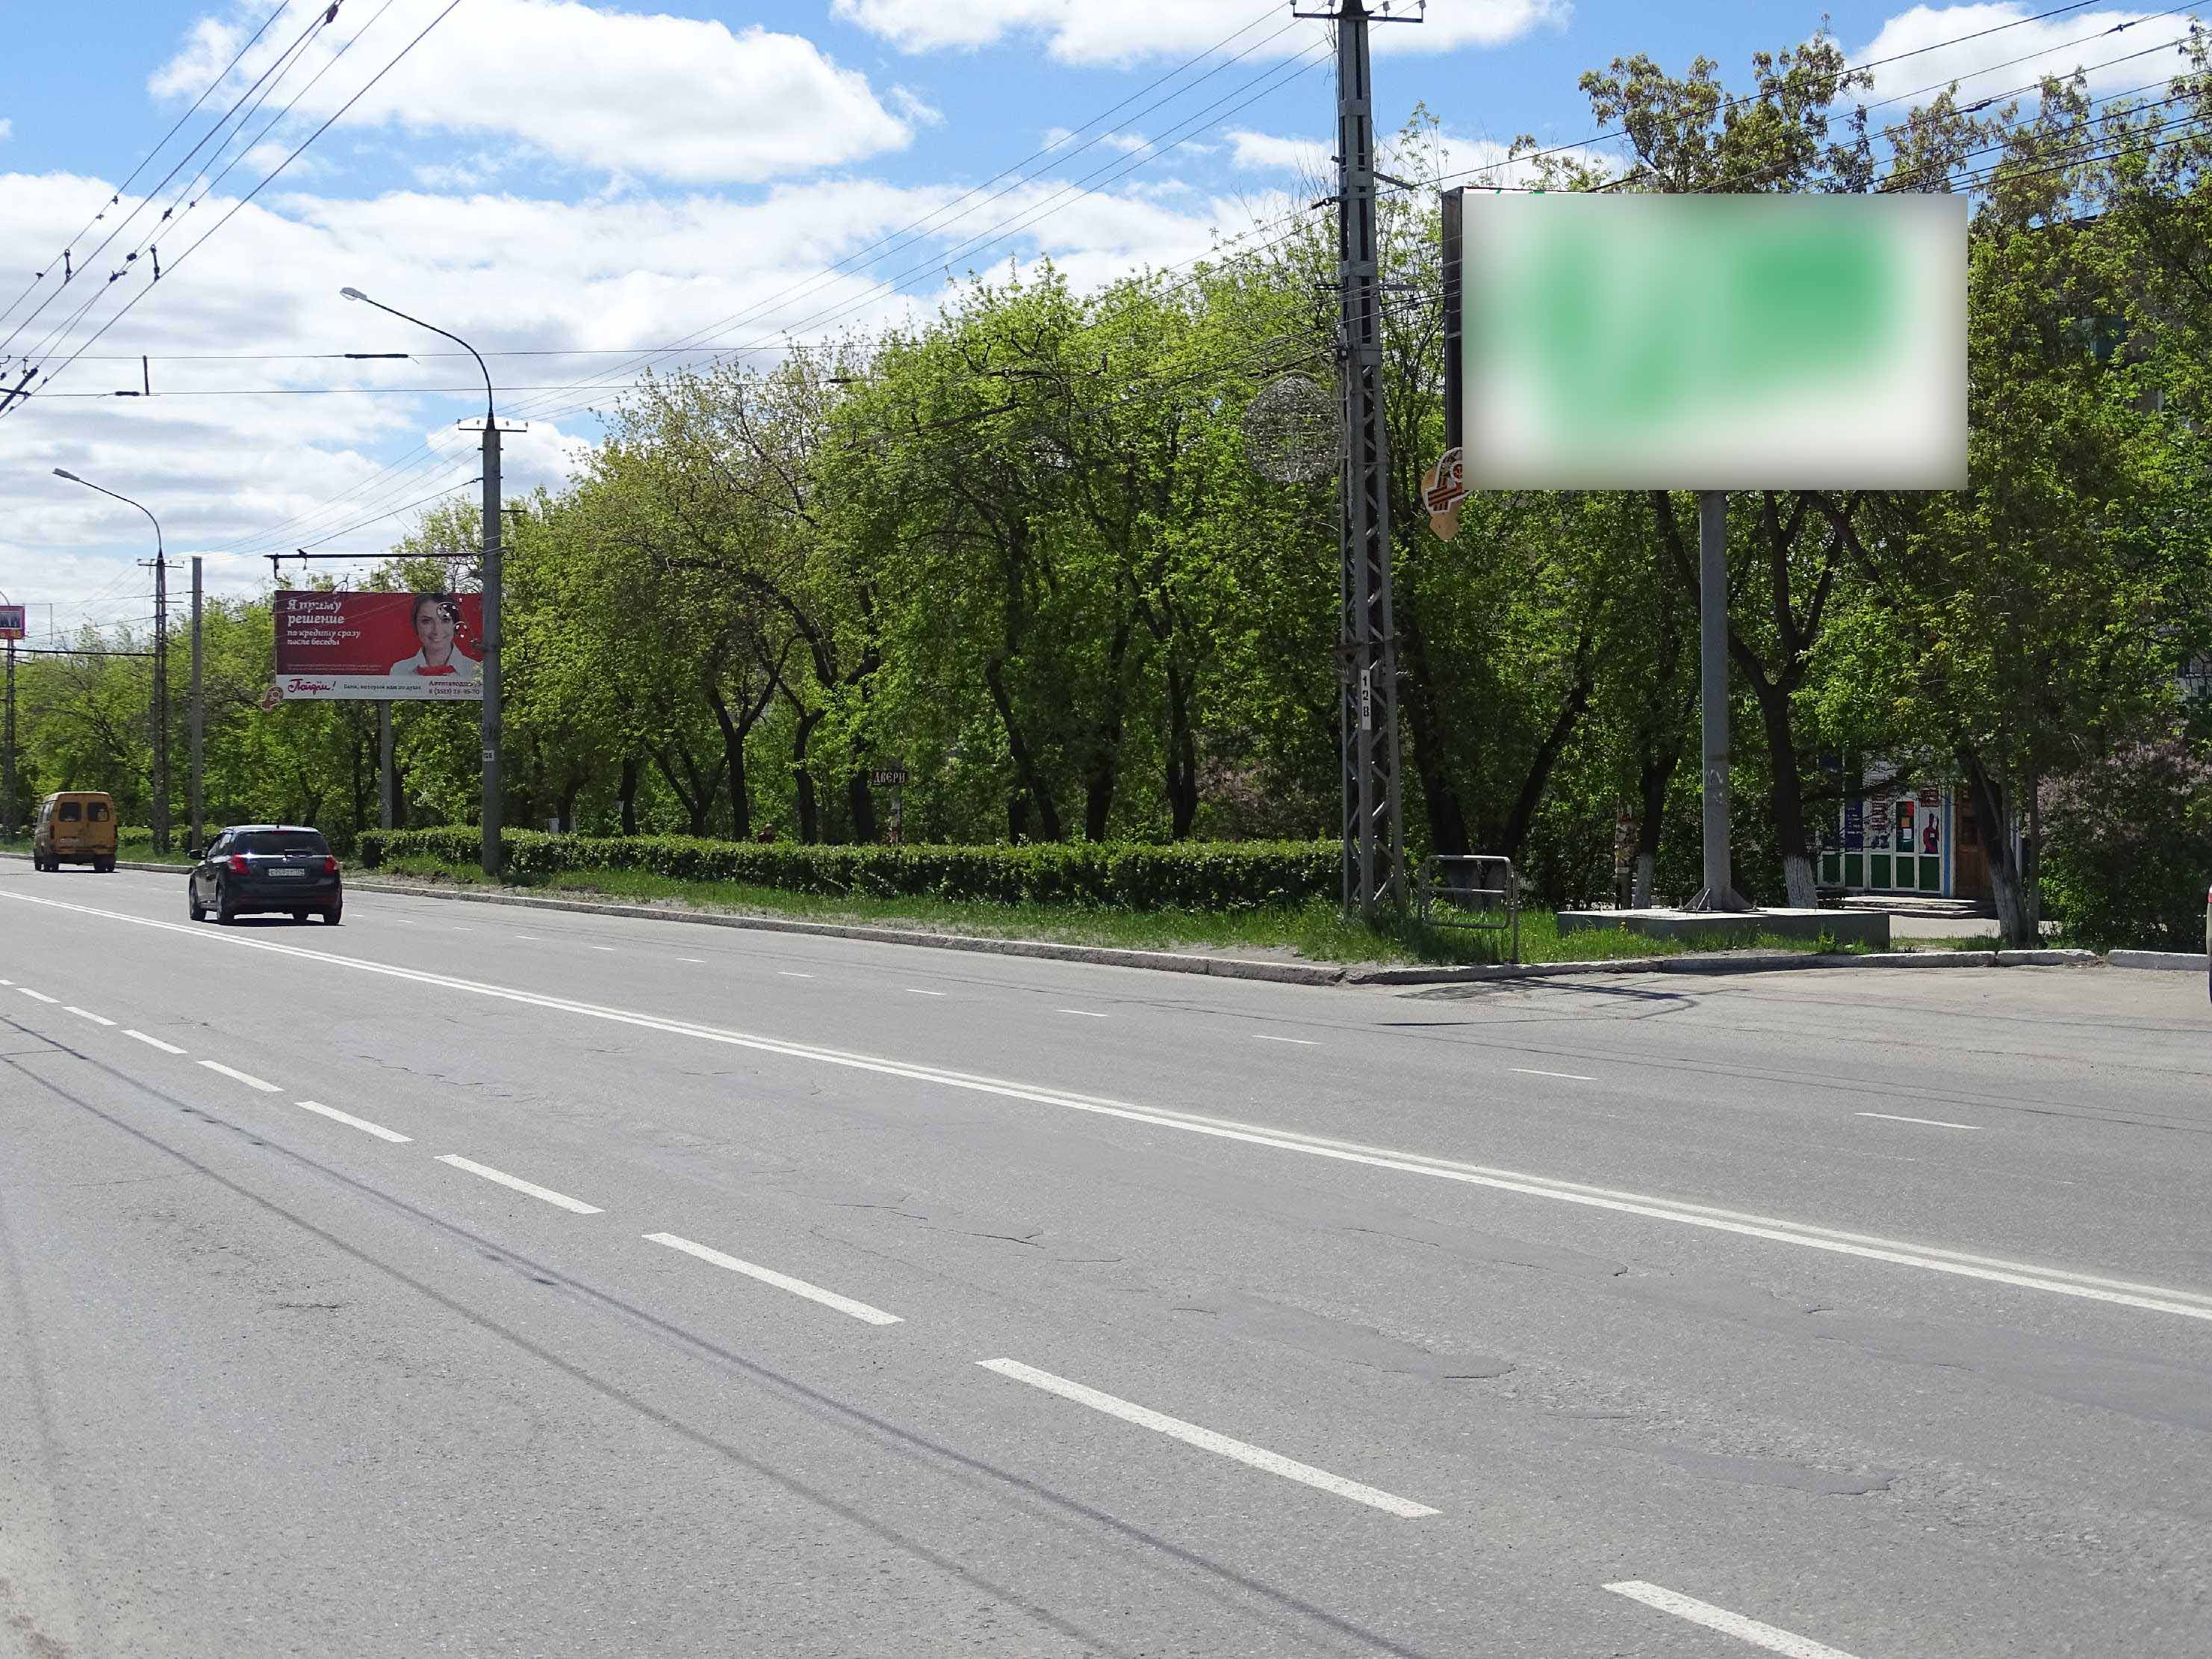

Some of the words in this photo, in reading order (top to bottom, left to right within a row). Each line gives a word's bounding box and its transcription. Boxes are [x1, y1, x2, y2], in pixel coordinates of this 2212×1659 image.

[287, 599, 297, 610] Я
[299, 601, 341, 613] приму
[288, 615, 345, 627] решение
[299, 629, 336, 638] кредиту
[338, 630, 361, 639] сразу
